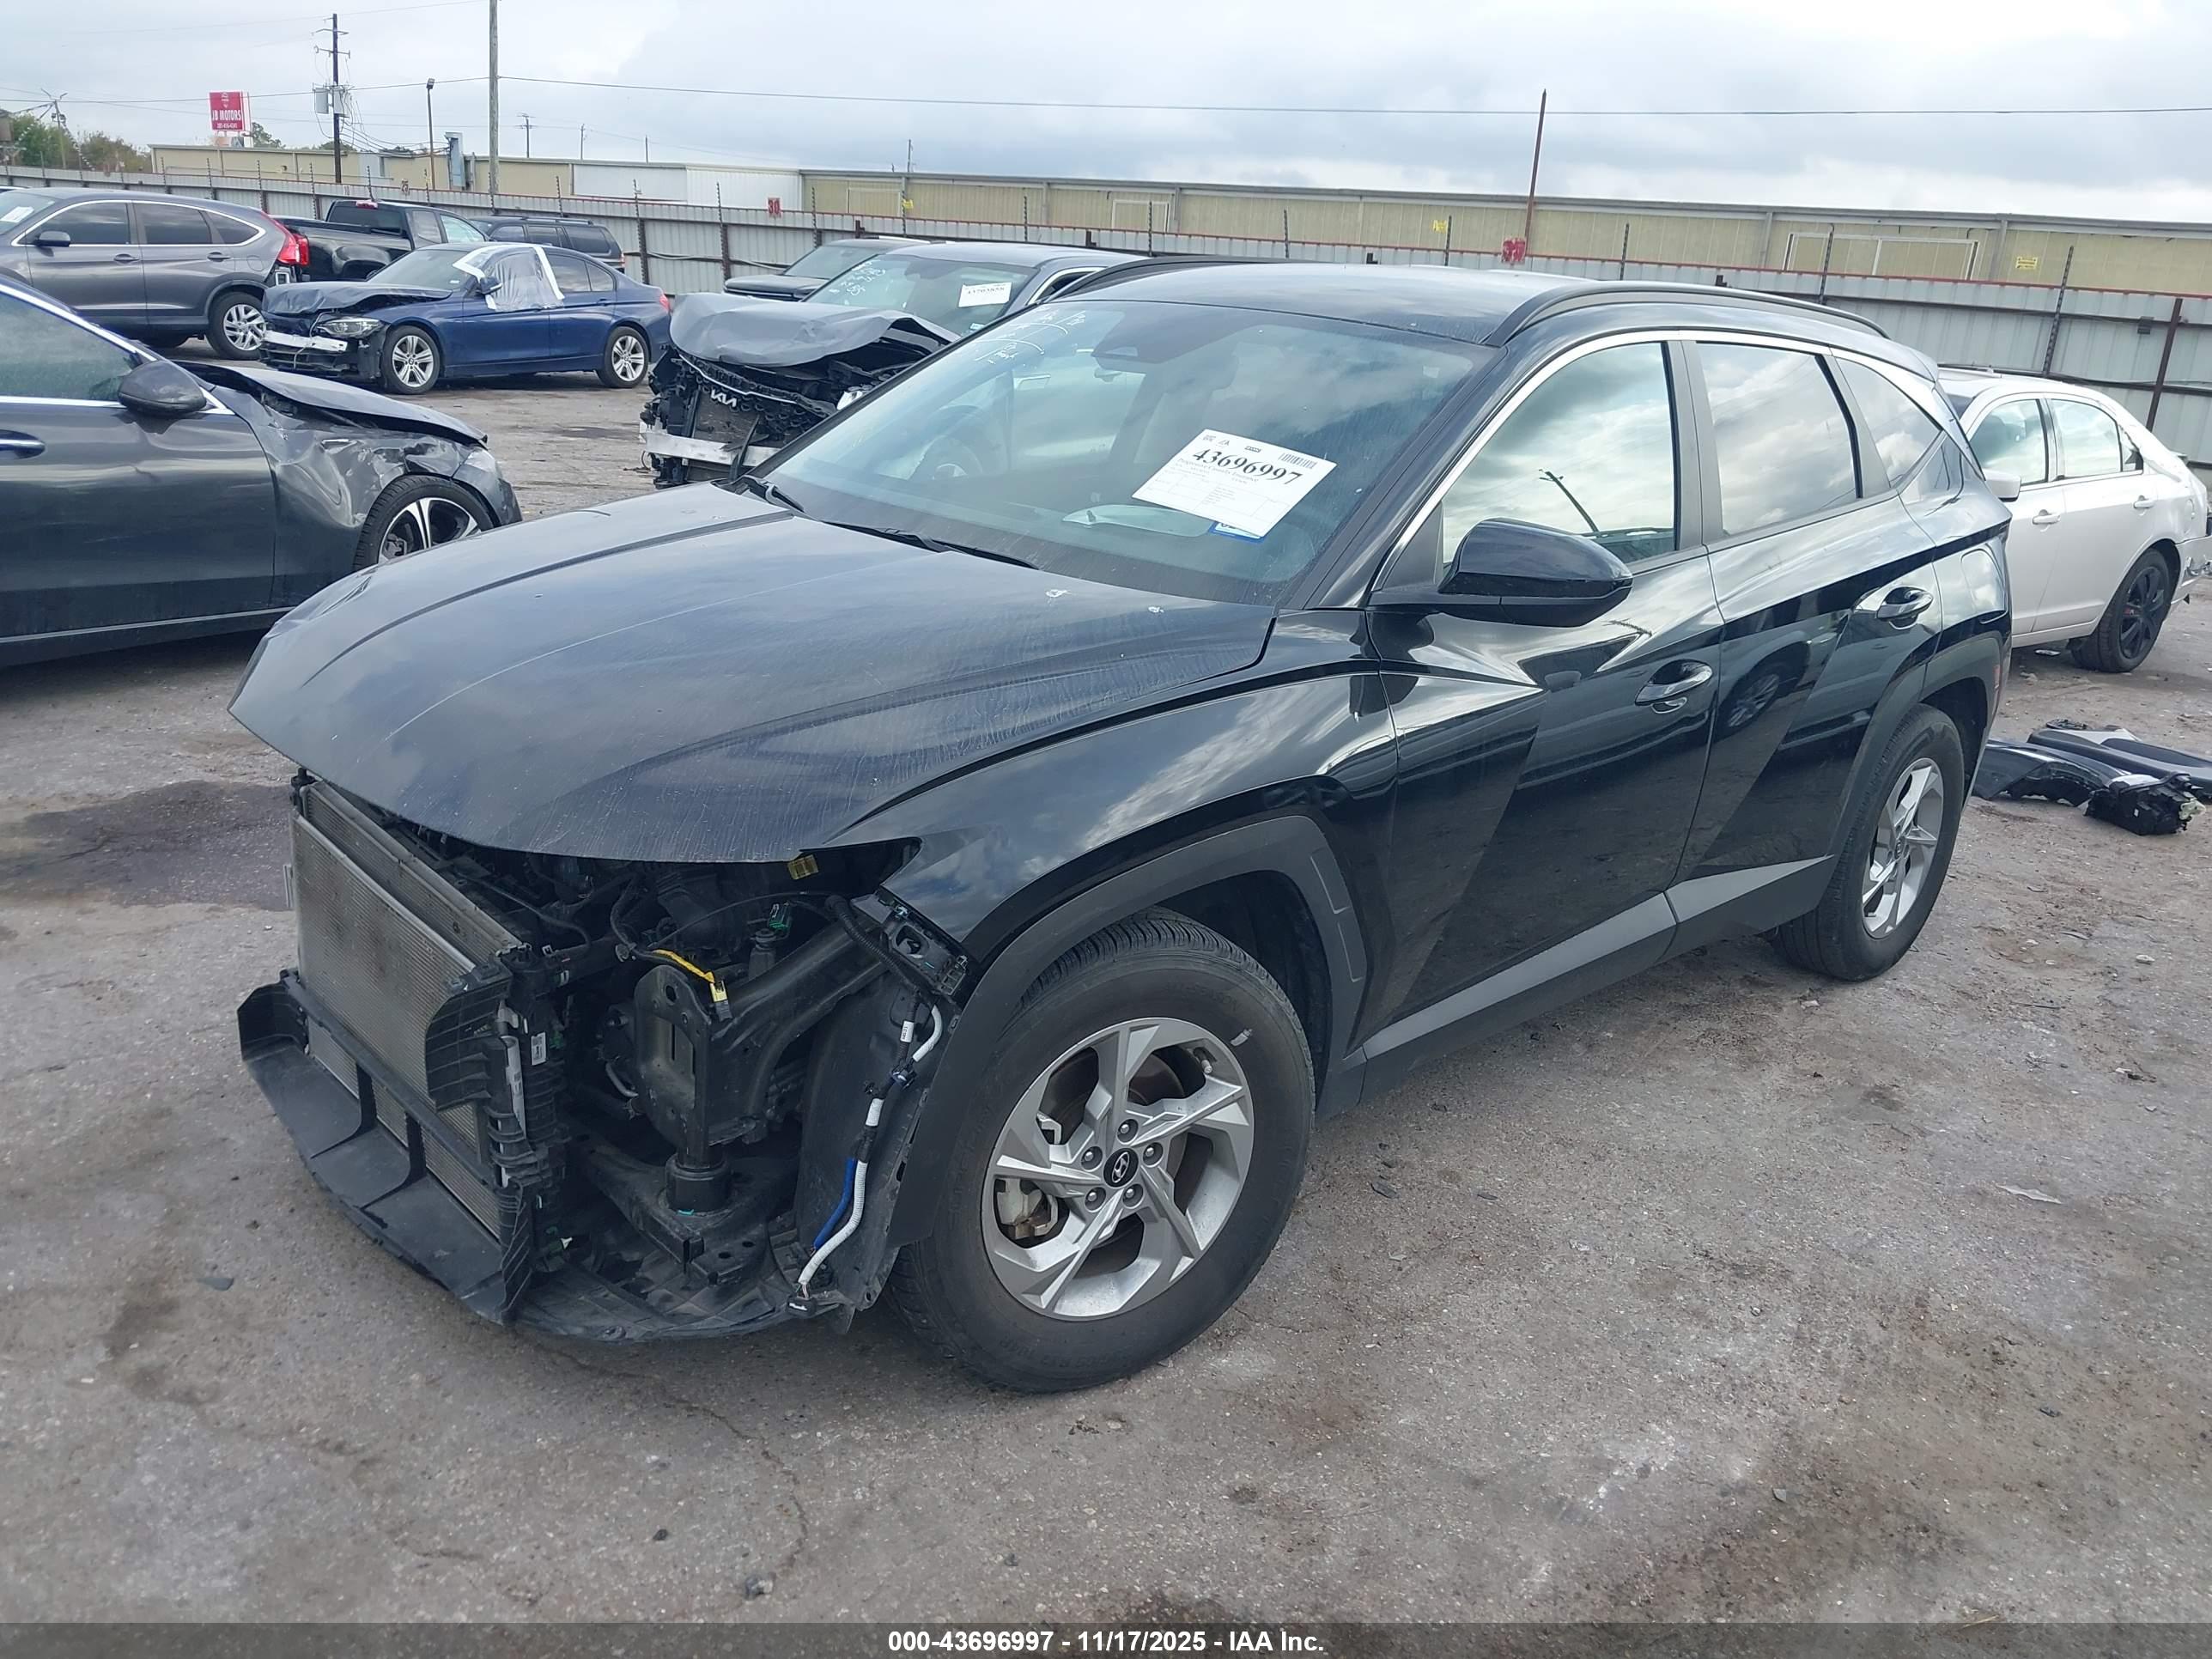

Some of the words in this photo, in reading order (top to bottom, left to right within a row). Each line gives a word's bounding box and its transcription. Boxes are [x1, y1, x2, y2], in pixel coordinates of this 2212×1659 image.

[219, 109, 241, 121] MOTORS
[767, 198, 781, 215] 30
[710, 388, 738, 408] KIA
[1192, 448, 1304, 485] 43696997
